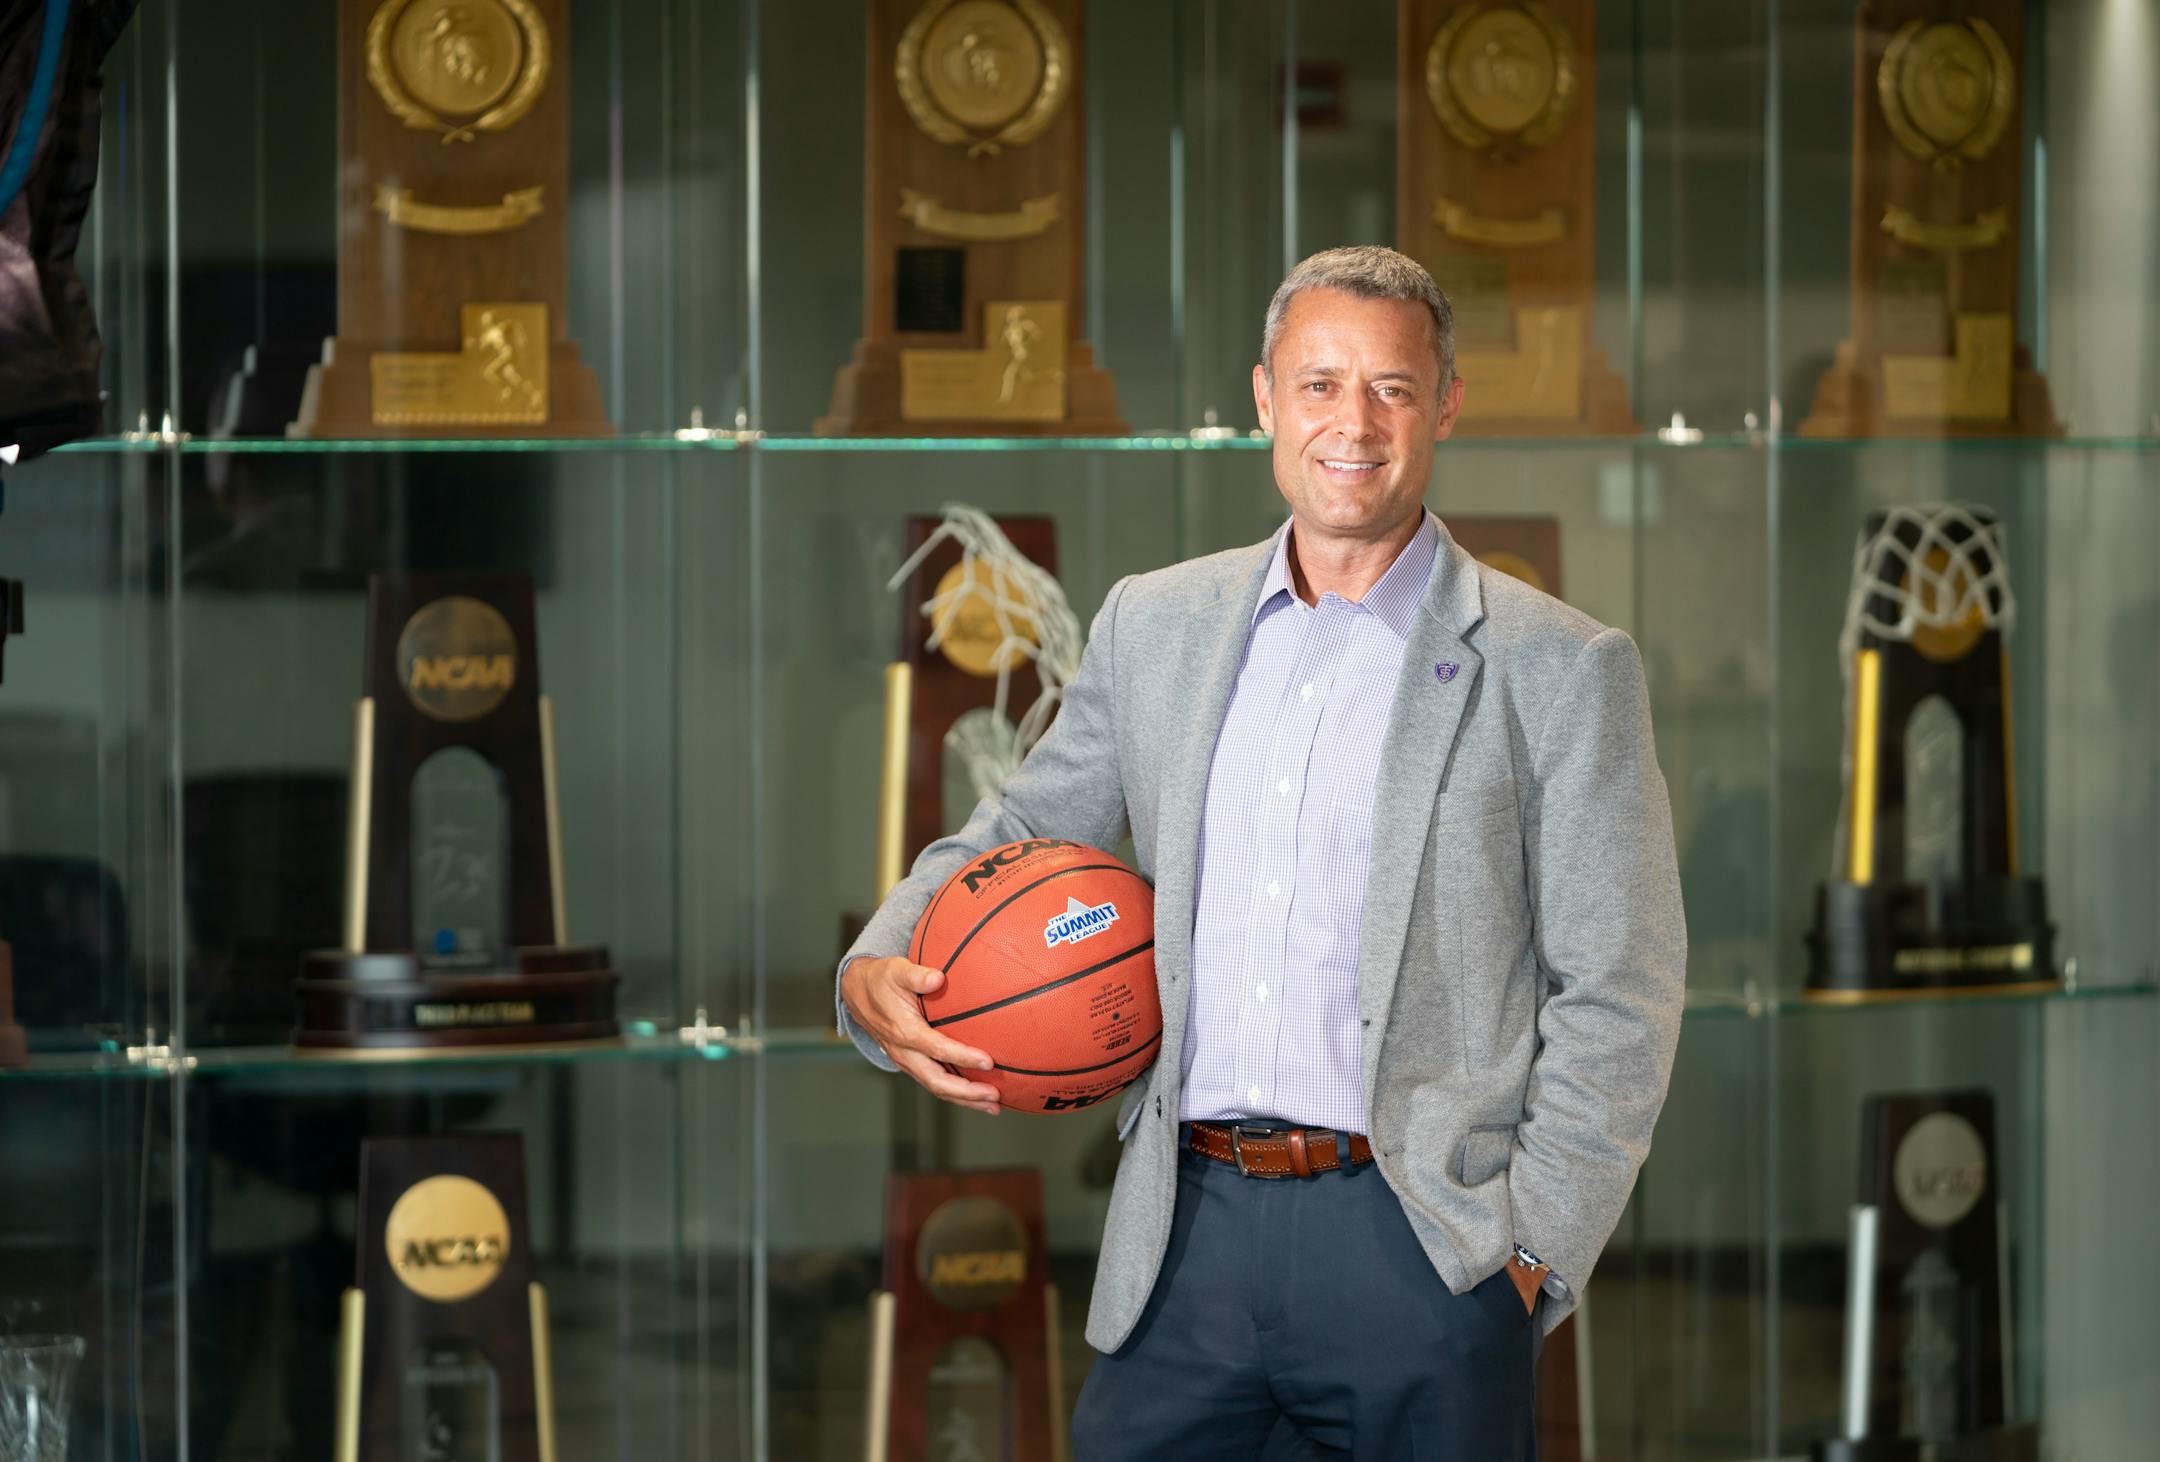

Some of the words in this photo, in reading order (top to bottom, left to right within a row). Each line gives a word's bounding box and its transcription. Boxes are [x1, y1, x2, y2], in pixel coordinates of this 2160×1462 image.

[411, 653, 513, 690] NCAA
[961, 840, 1084, 894] NCAA
[1047, 905, 1115, 943] SUMMIT
[1051, 914, 1067, 925] THE
[1070, 923, 1108, 942] LEAGUE
[402, 1236, 501, 1269] NCAA
